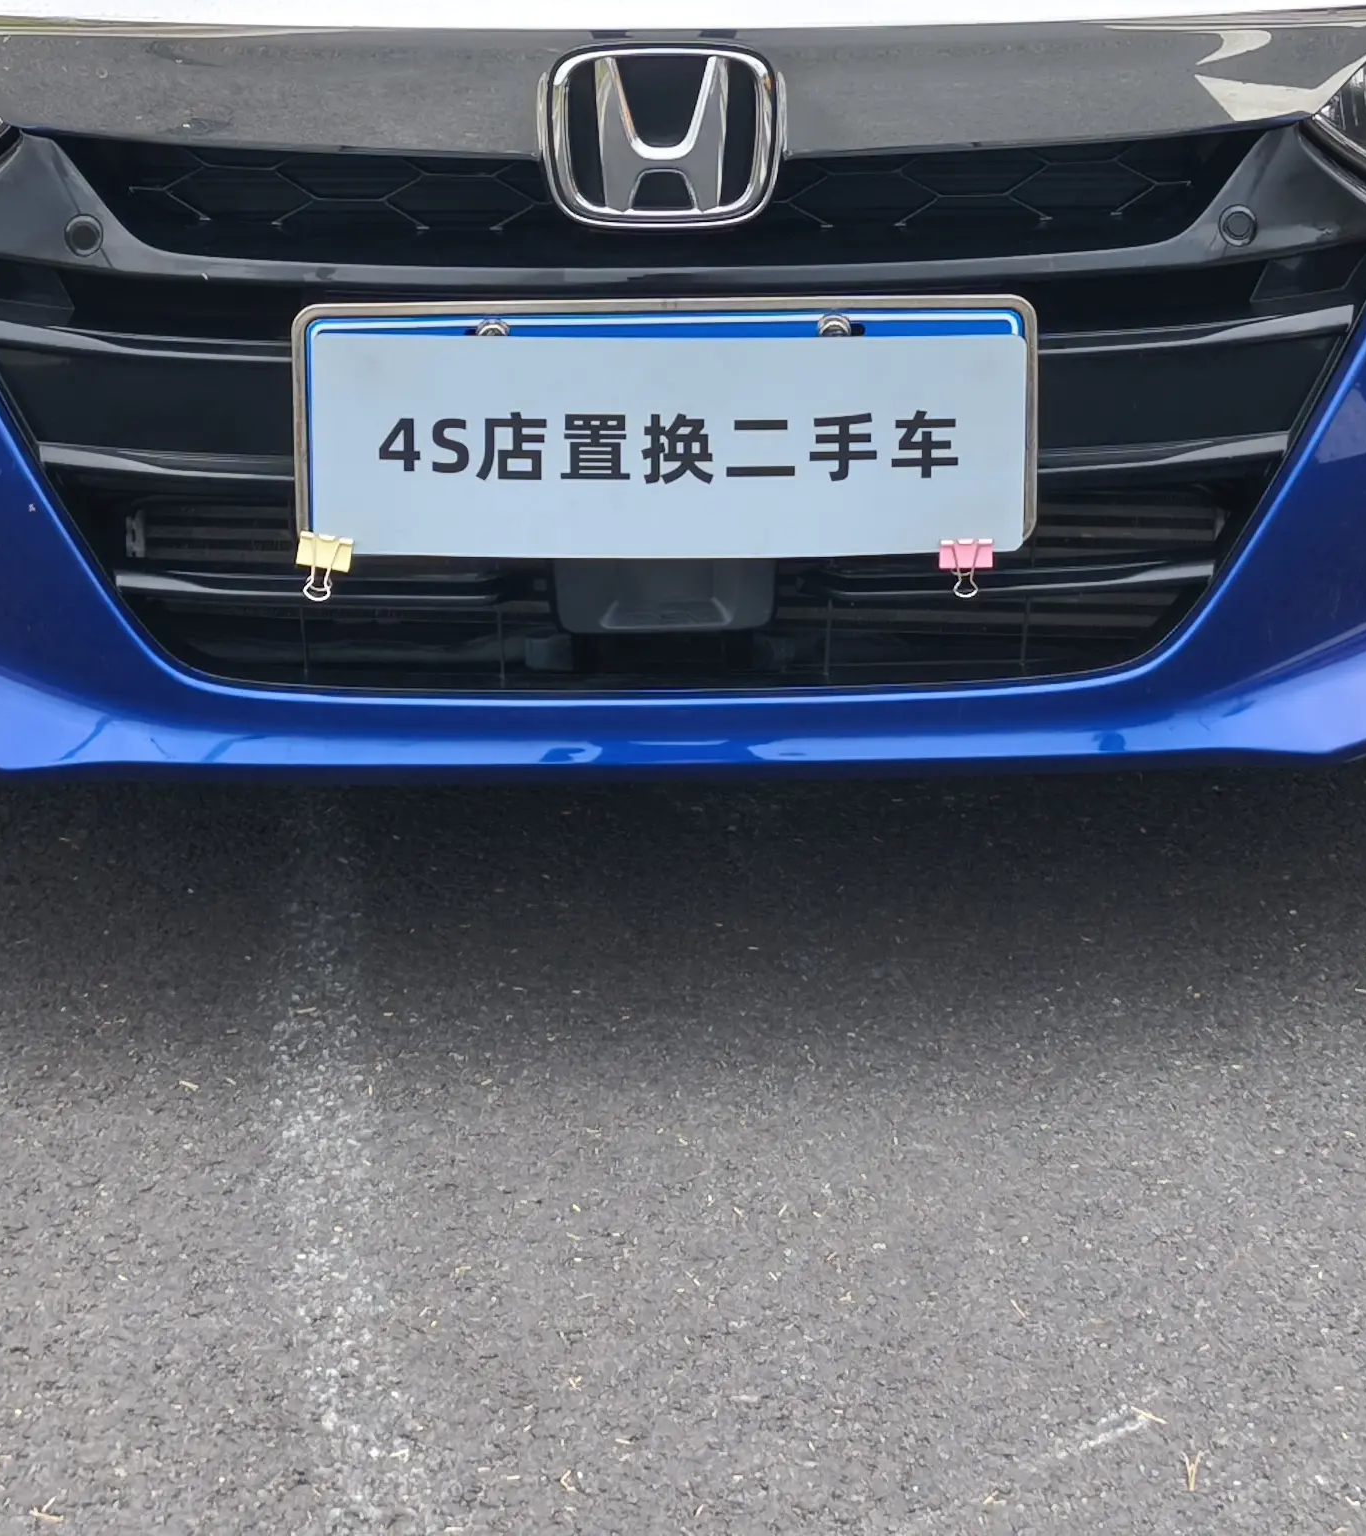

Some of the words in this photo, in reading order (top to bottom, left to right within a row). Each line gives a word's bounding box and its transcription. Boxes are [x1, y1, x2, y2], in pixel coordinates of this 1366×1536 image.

[378, 410, 959, 484] 4S店置换二手车
